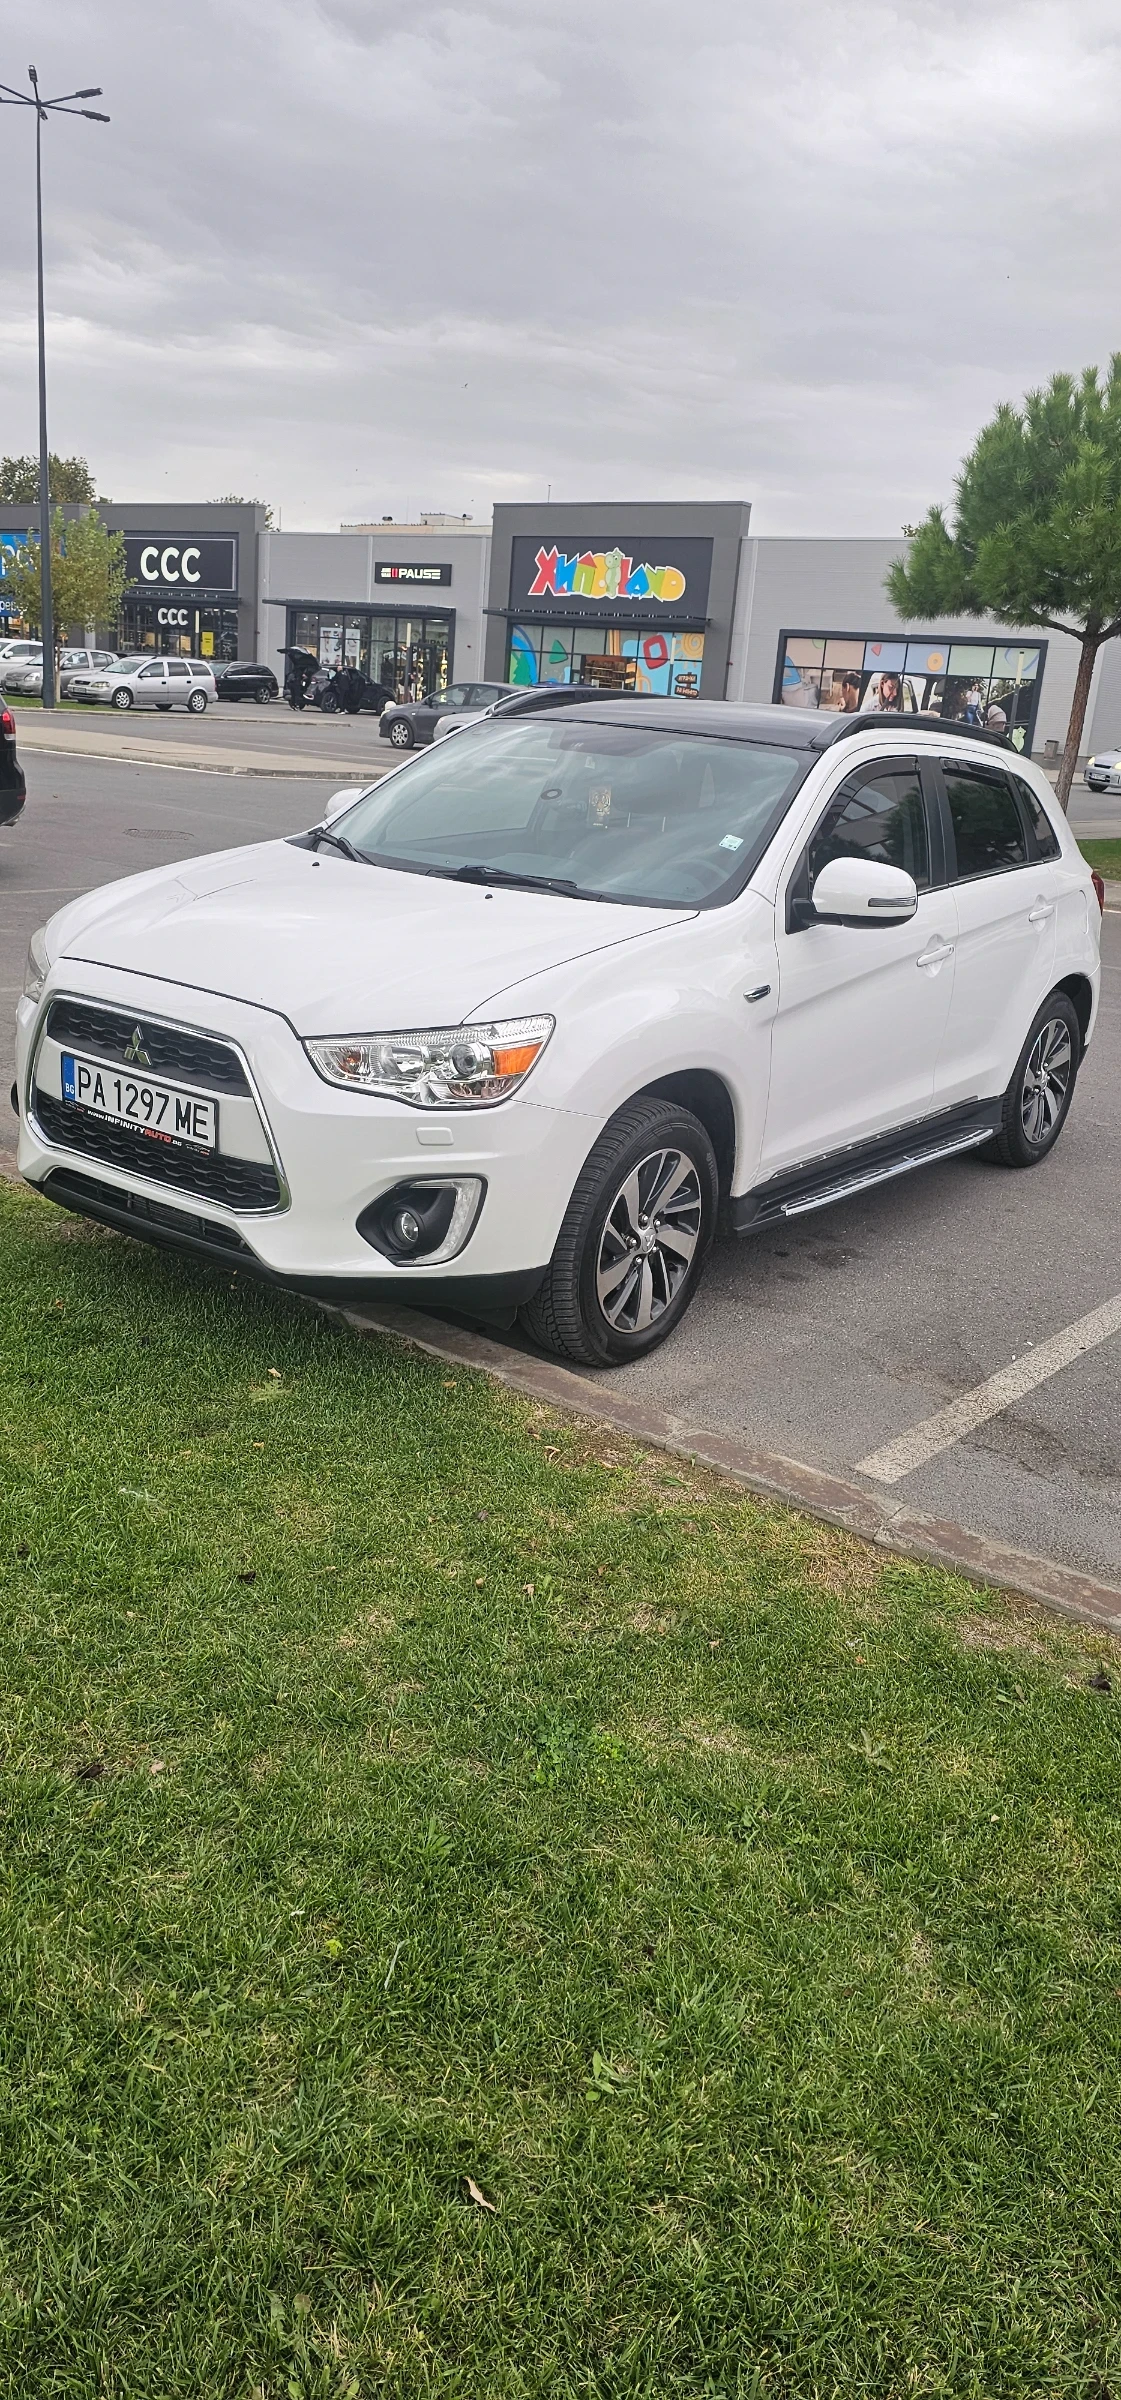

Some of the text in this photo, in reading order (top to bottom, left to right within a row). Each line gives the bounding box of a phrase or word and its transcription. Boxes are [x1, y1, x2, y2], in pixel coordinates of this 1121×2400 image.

[140, 546, 201, 582] CCC
[157, 607, 189, 626] CCC
[65, 1082, 75, 1095] BG
[77, 1065, 209, 1141] PA 1297 ME
